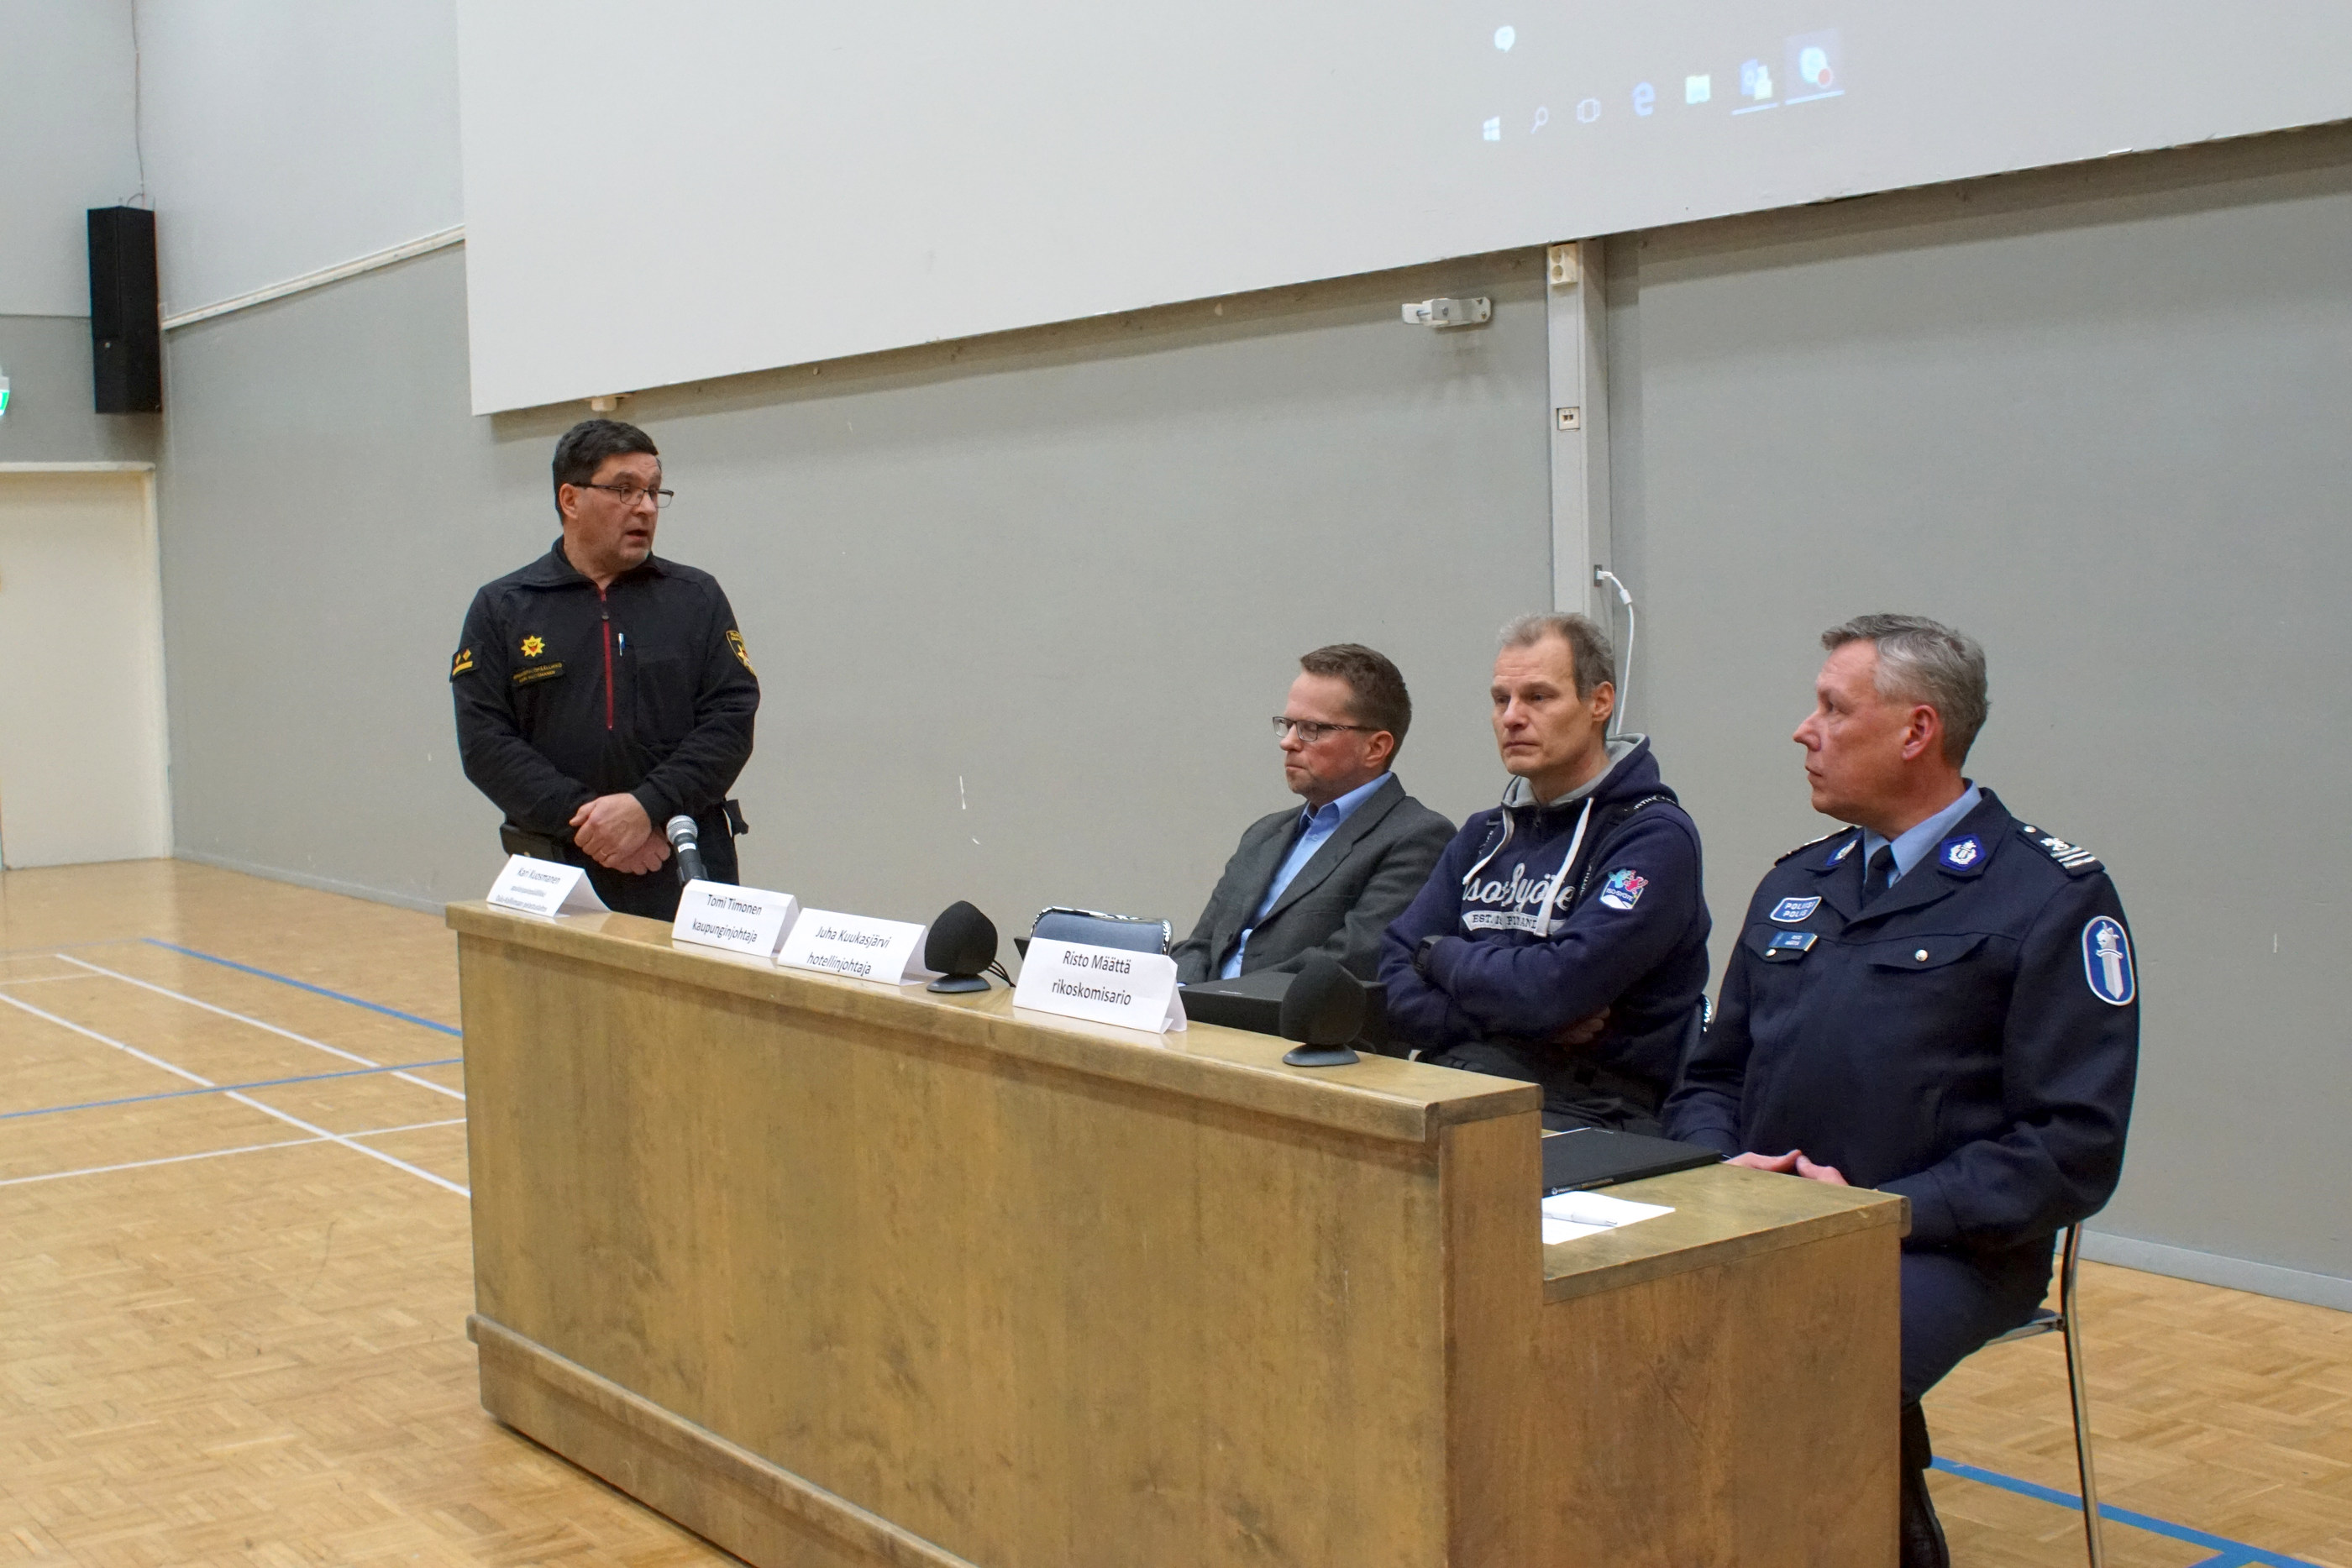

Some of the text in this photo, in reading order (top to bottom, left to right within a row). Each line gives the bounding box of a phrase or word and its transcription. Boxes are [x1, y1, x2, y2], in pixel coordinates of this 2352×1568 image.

[706, 894, 762, 915] Tomi Timonen
[692, 918, 758, 944] kaupunginjohtaja
[1472, 914, 1493, 924] EST.
[816, 926, 892, 949] Juha Kuukasjärvi
[806, 952, 872, 977] hotellinjohtaja
[1063, 950, 1131, 974] Risto Määttä
[1052, 978, 1131, 1005] rikoskomisario
